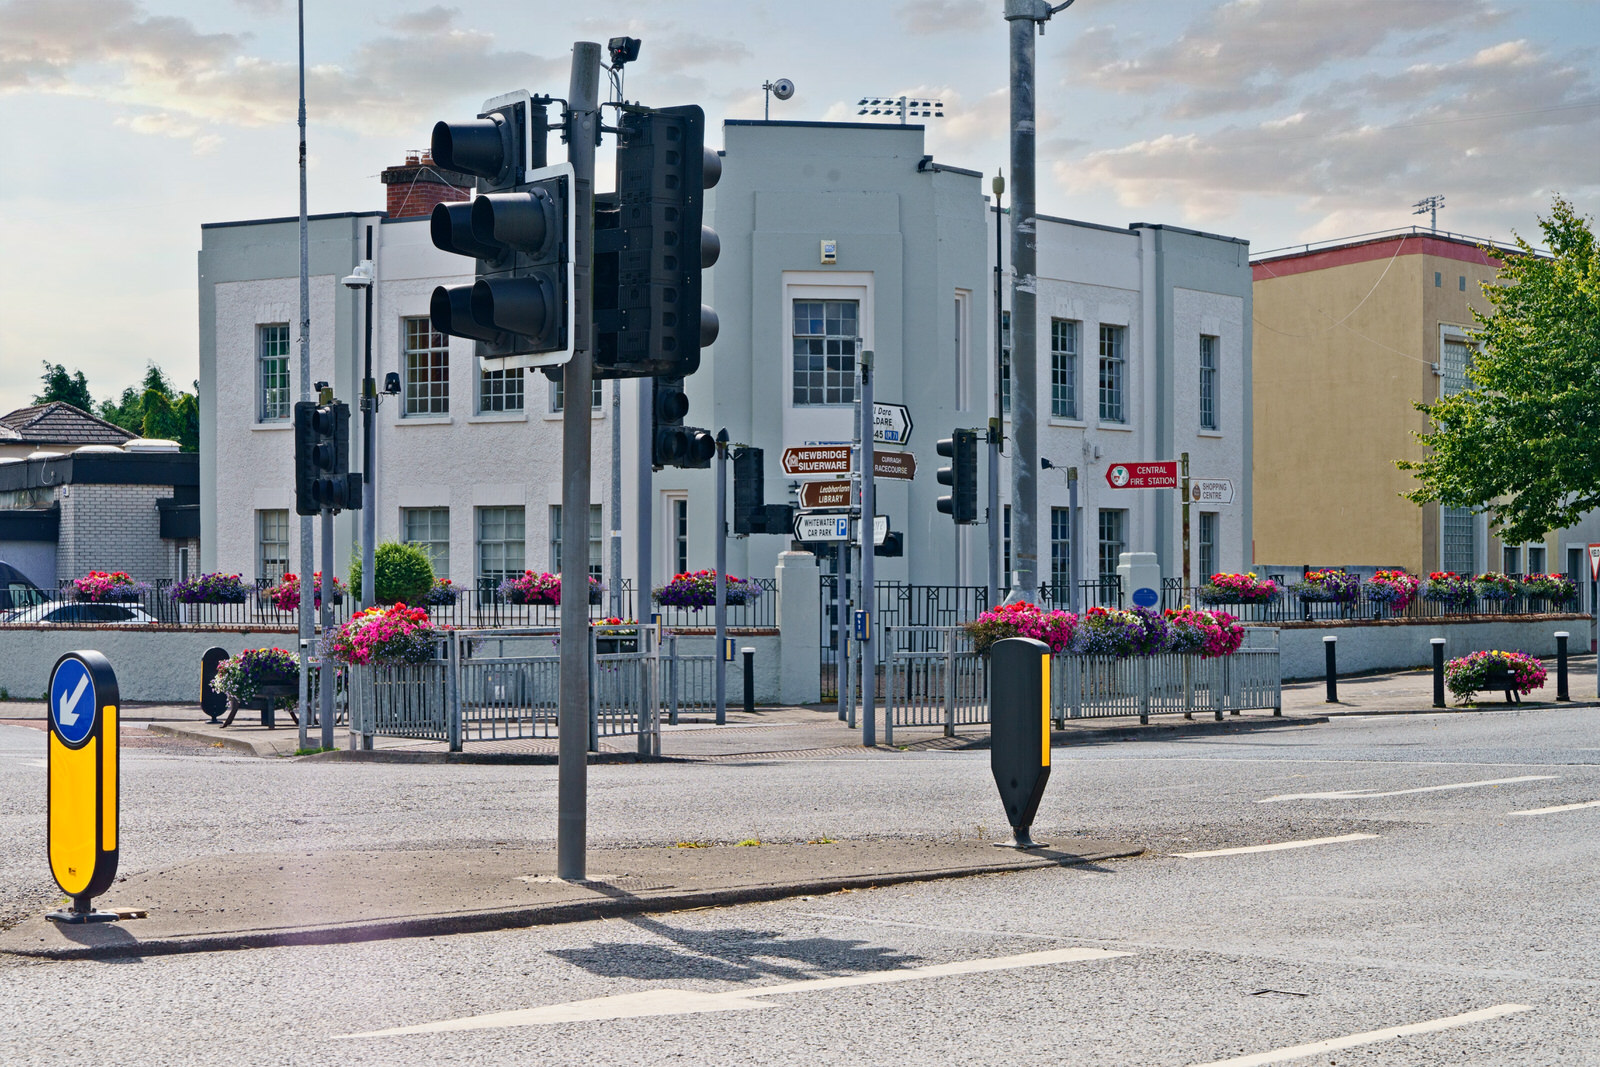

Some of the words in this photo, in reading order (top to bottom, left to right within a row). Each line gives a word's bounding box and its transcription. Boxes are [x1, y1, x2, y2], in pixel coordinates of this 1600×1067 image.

[878, 406, 892, 416] Dara
[873, 416, 892, 426] DARE
[798, 450, 848, 460] NEWBRIDGE
[798, 461, 848, 470] SILVERWARE
[874, 464, 908, 474] RACECOURSE
[1136, 466, 1167, 474] CENTRAL
[1130, 478, 1144, 486] FIRE
[1148, 476, 1175, 485] STATION
[1202, 482, 1226, 490] SHOPPING
[820, 484, 850, 494] Leabharlann
[818, 494, 844, 504] LIBRARY
[804, 518, 836, 526] WHITEWATER
[819, 528, 832, 536] PARK
[838, 520, 846, 535] P
